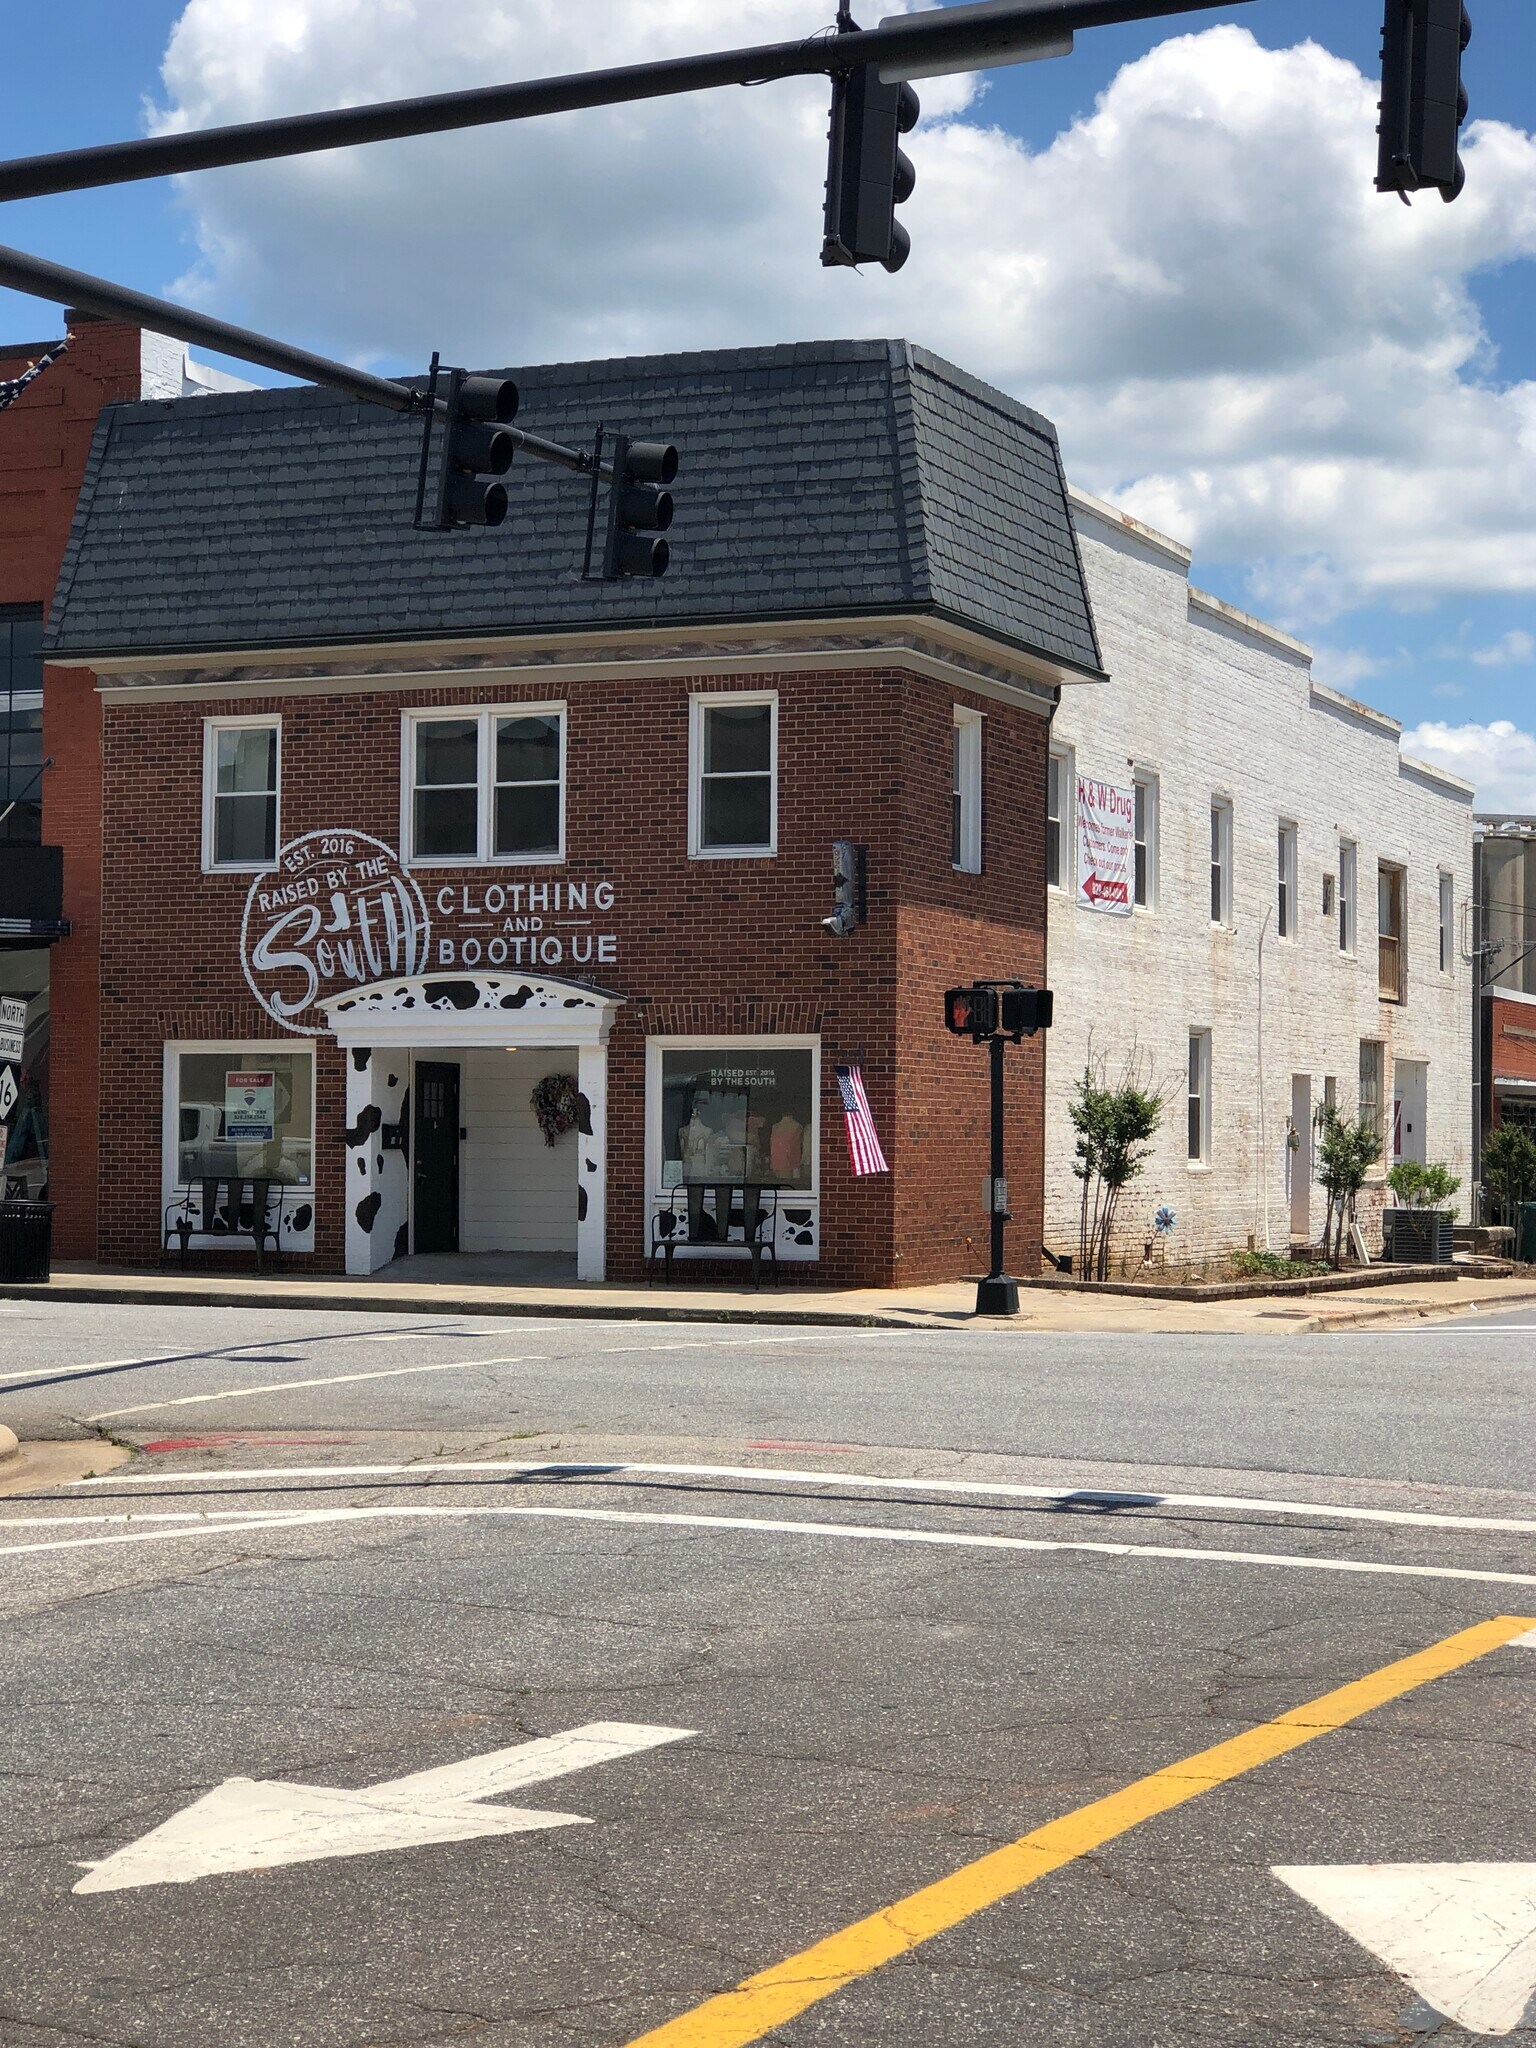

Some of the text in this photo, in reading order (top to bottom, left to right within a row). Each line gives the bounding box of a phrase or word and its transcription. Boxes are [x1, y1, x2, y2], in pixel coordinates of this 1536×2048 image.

[1078, 778, 1132, 824] H & W Drug
[284, 838, 355, 872] EST. 2016
[259, 855, 389, 912] RAISED BY THE
[437, 882, 615, 915] CLOTHING
[502, 916, 543, 932] AND
[439, 935, 617, 965] BOOTIQUE
[1, 1004, 25, 1024] NORTH
[0, 1037, 21, 1054] BUSINESS
[710, 1069, 744, 1077] RAISED
[710, 1077, 776, 1085] BY THE SOUTH
